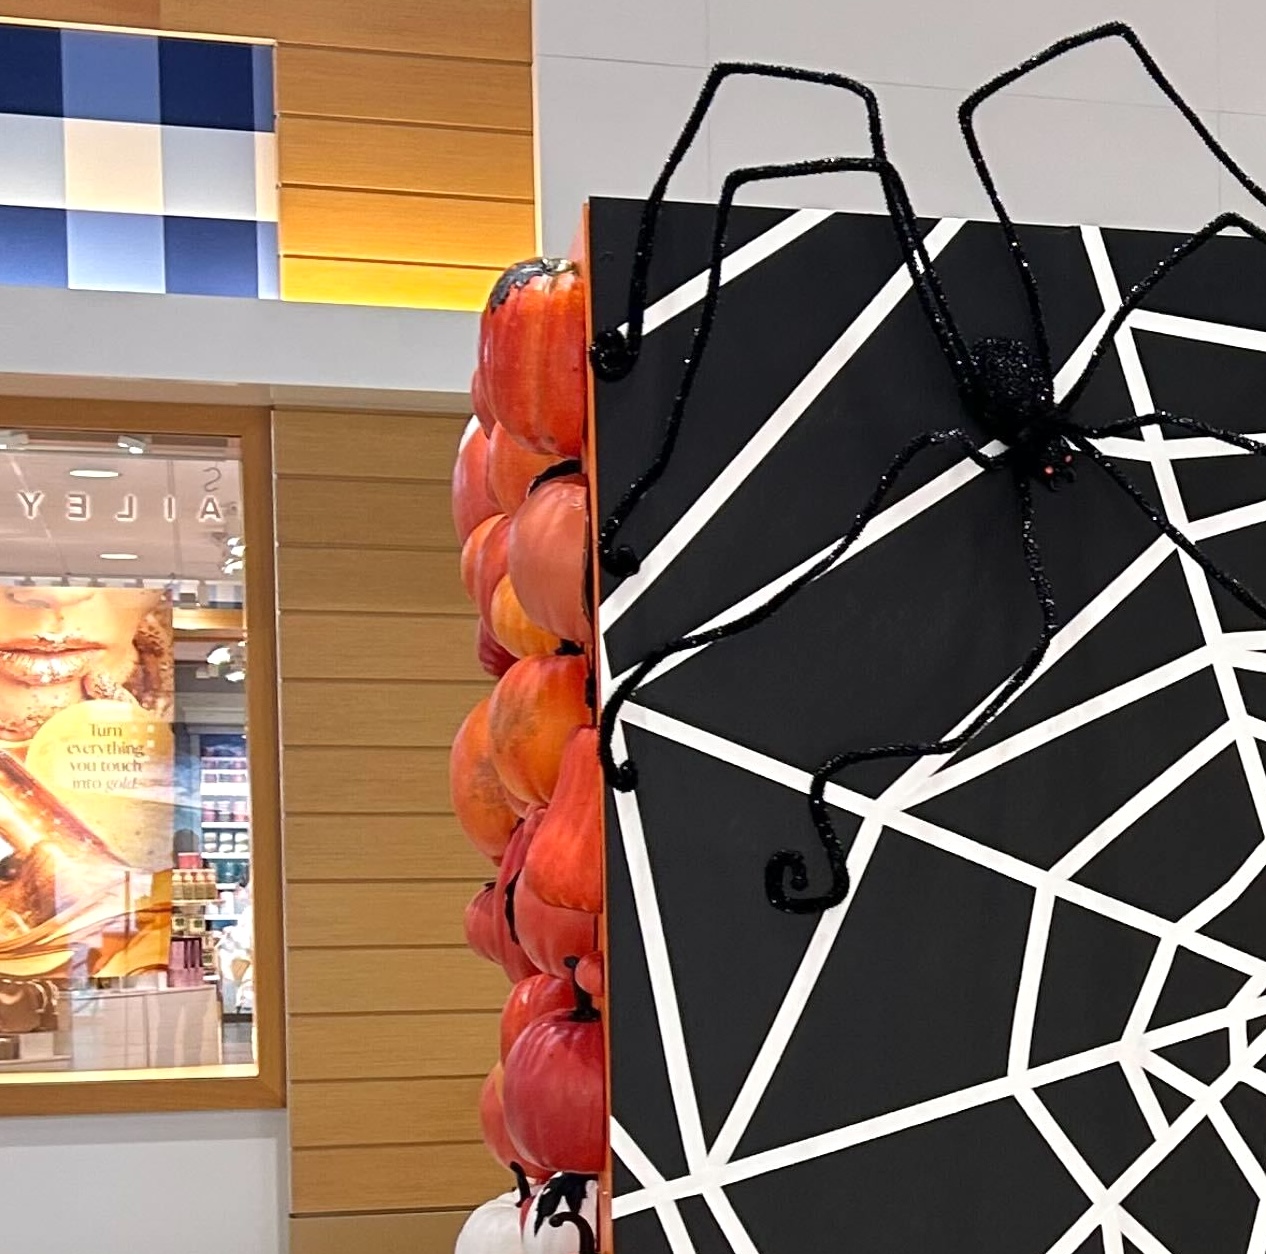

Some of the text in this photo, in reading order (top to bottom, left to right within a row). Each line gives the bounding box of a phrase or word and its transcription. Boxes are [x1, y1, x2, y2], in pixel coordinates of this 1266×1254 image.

[89, 723, 122, 737] Turn
[67, 741, 145, 758] everything
[70, 759, 142, 774] you touch
[73, 778, 102, 789] into
